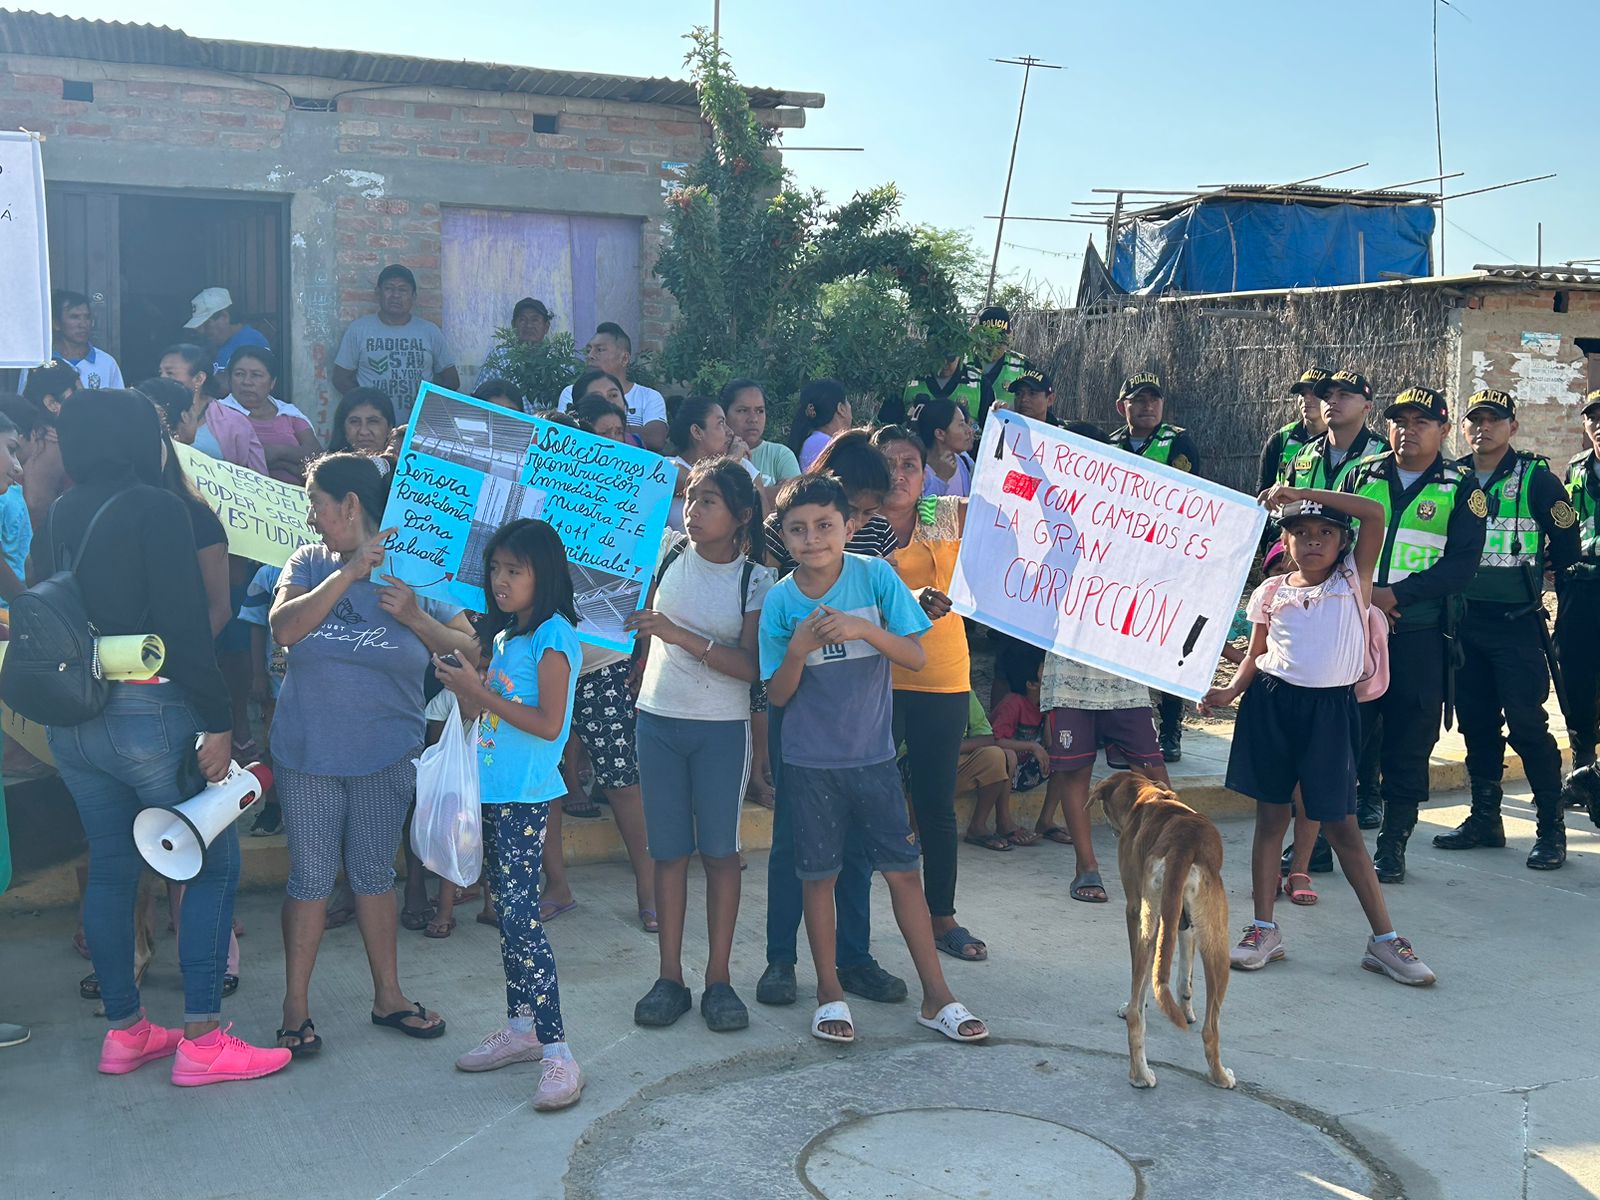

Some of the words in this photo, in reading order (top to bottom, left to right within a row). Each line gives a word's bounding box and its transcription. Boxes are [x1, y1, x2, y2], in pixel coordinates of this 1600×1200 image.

[366, 337, 426, 352] RADICAL
[1017, 369, 1044, 382] LICIA
[1129, 372, 1161, 388] POLICIA
[1468, 389, 1508, 408] POLICIA
[190, 457, 215, 478] MI
[232, 476, 309, 515] ESCUEL
[396, 453, 470, 497] Señora
[647, 461, 668, 484] la
[196, 475, 257, 513] PODER
[397, 478, 473, 522] Presidenta
[614, 500, 640, 514] de
[404, 509, 453, 539] Dina
[994, 504, 1019, 535] LA
[1034, 519, 1112, 564] GRAN
[1044, 485, 1087, 516] CON
[1184, 533, 1212, 559] ES
[384, 531, 450, 567] Boluarte
[599, 531, 616, 548] de
